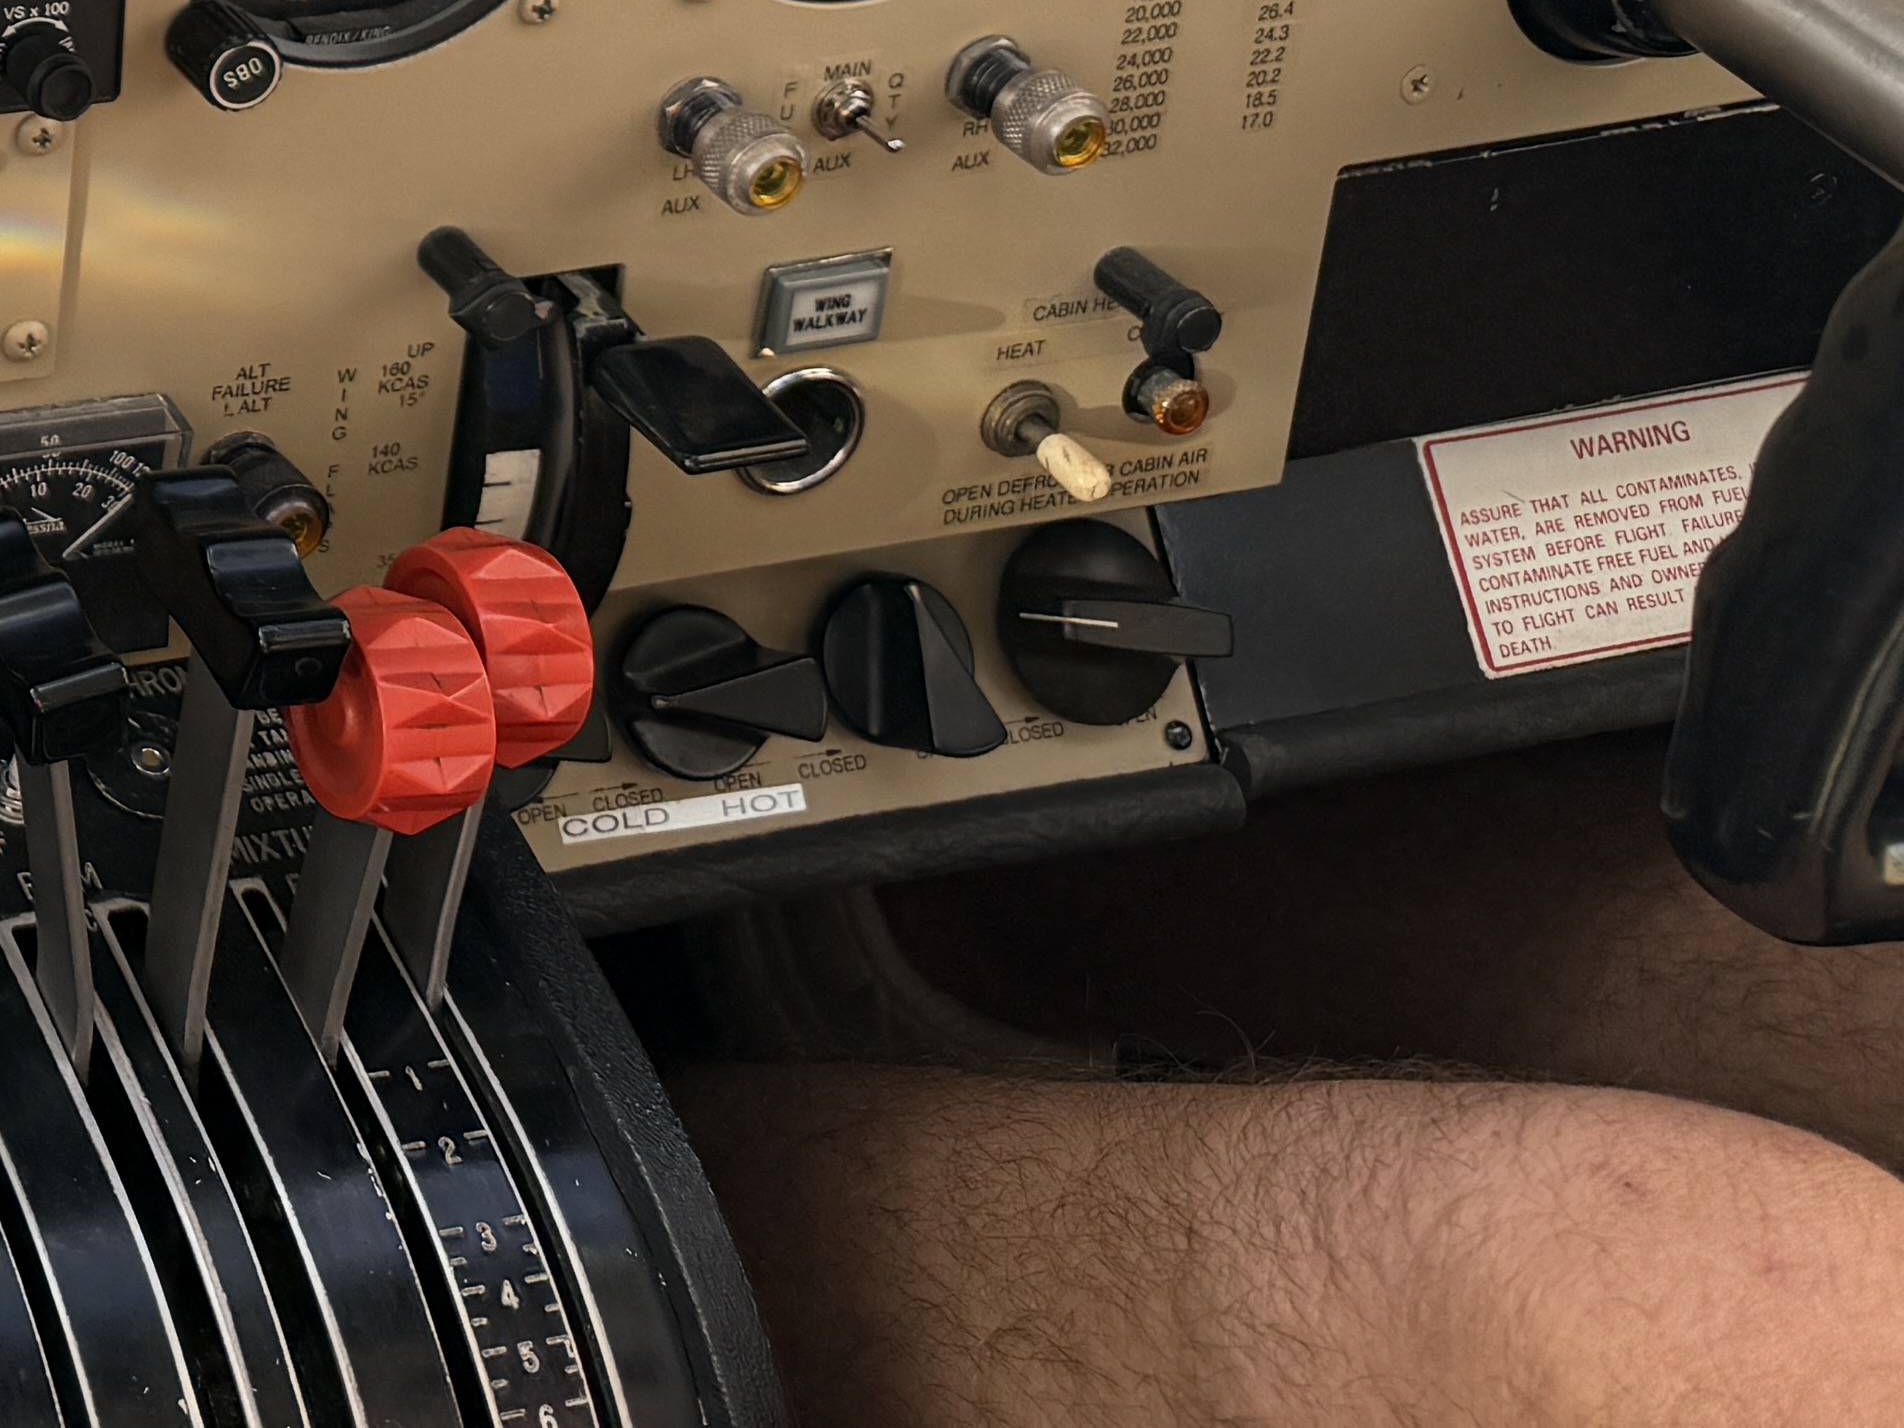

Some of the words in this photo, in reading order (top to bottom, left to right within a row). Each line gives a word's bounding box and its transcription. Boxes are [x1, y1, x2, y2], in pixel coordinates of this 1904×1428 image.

[1571, 420, 1691, 460] WARNING
[1460, 503, 1523, 526] ASSURE
[1530, 494, 1569, 513] THAT
[1580, 488, 1608, 506] ALL
[561, 805, 671, 839] COLD
[721, 789, 800, 818] HOT
